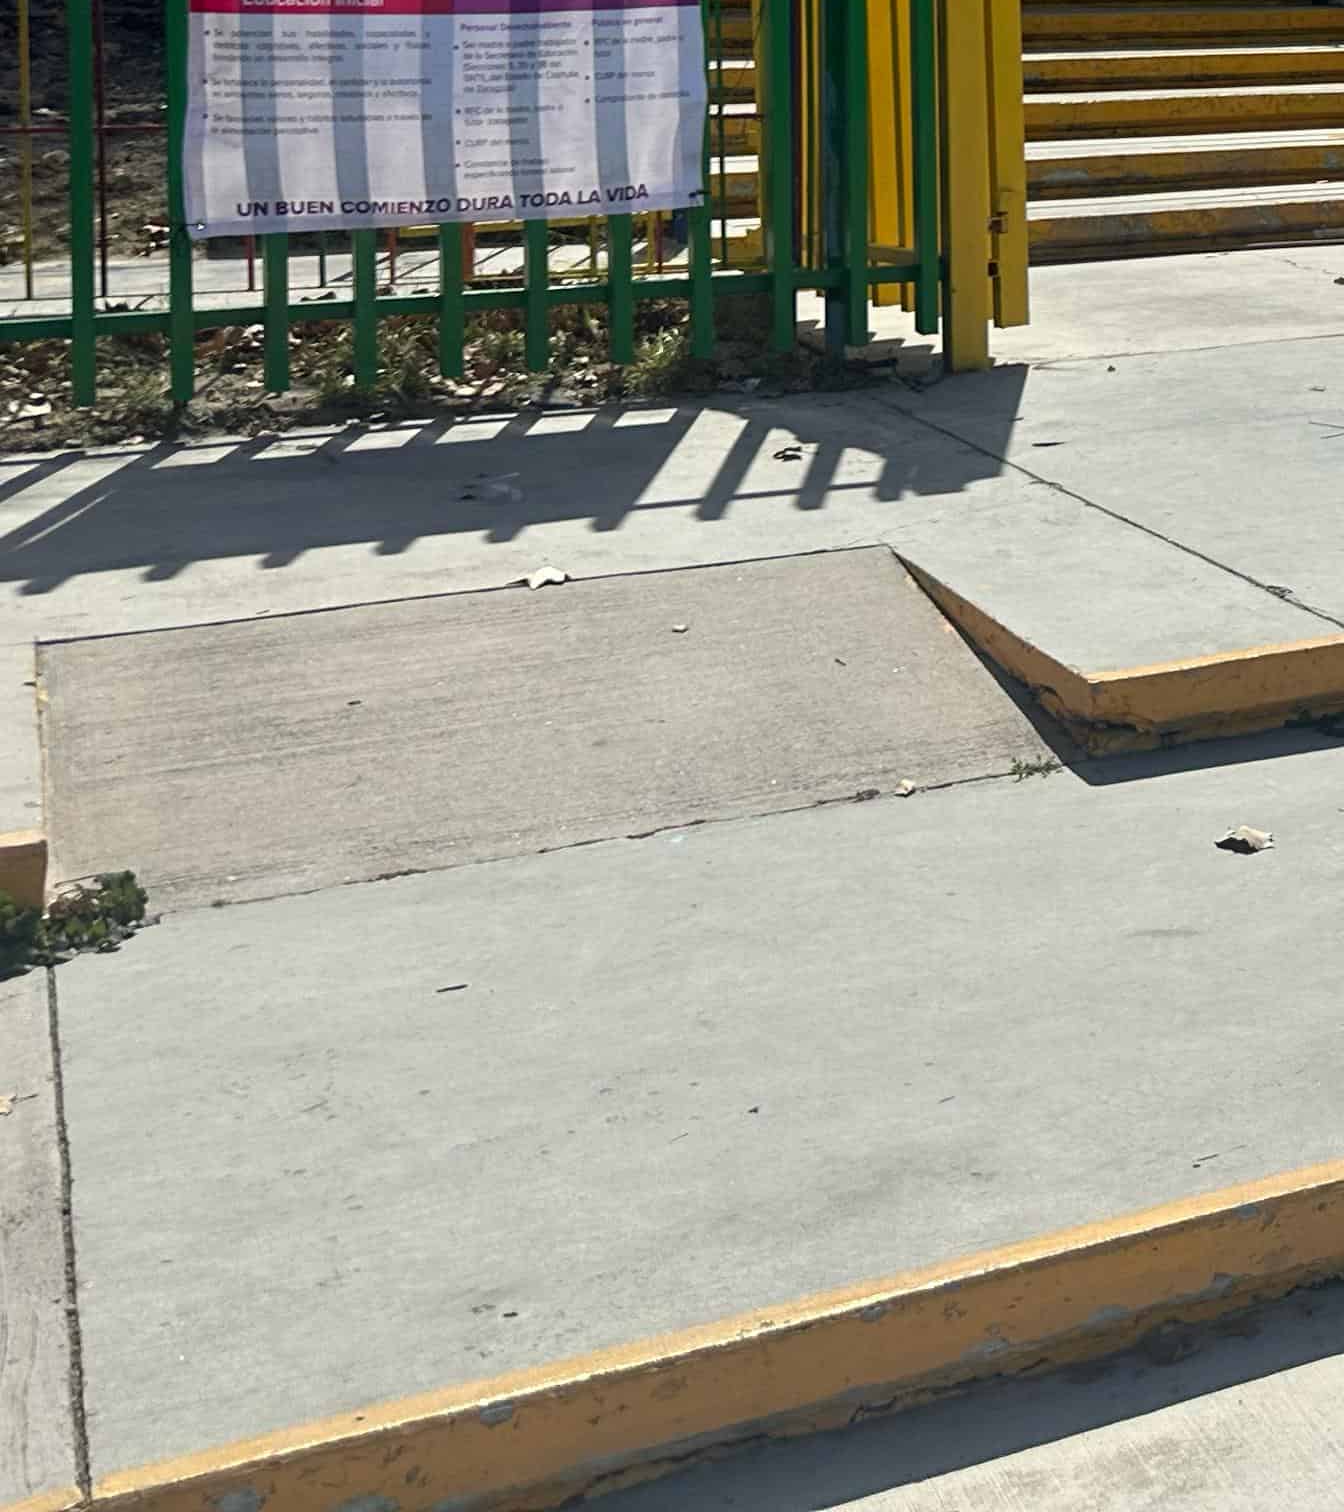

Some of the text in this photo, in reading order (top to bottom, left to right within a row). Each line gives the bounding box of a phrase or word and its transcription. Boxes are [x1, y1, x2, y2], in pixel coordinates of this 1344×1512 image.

[236, 183, 649, 217] UN BUEN COMIENZO DURA TODA LA VIDA
